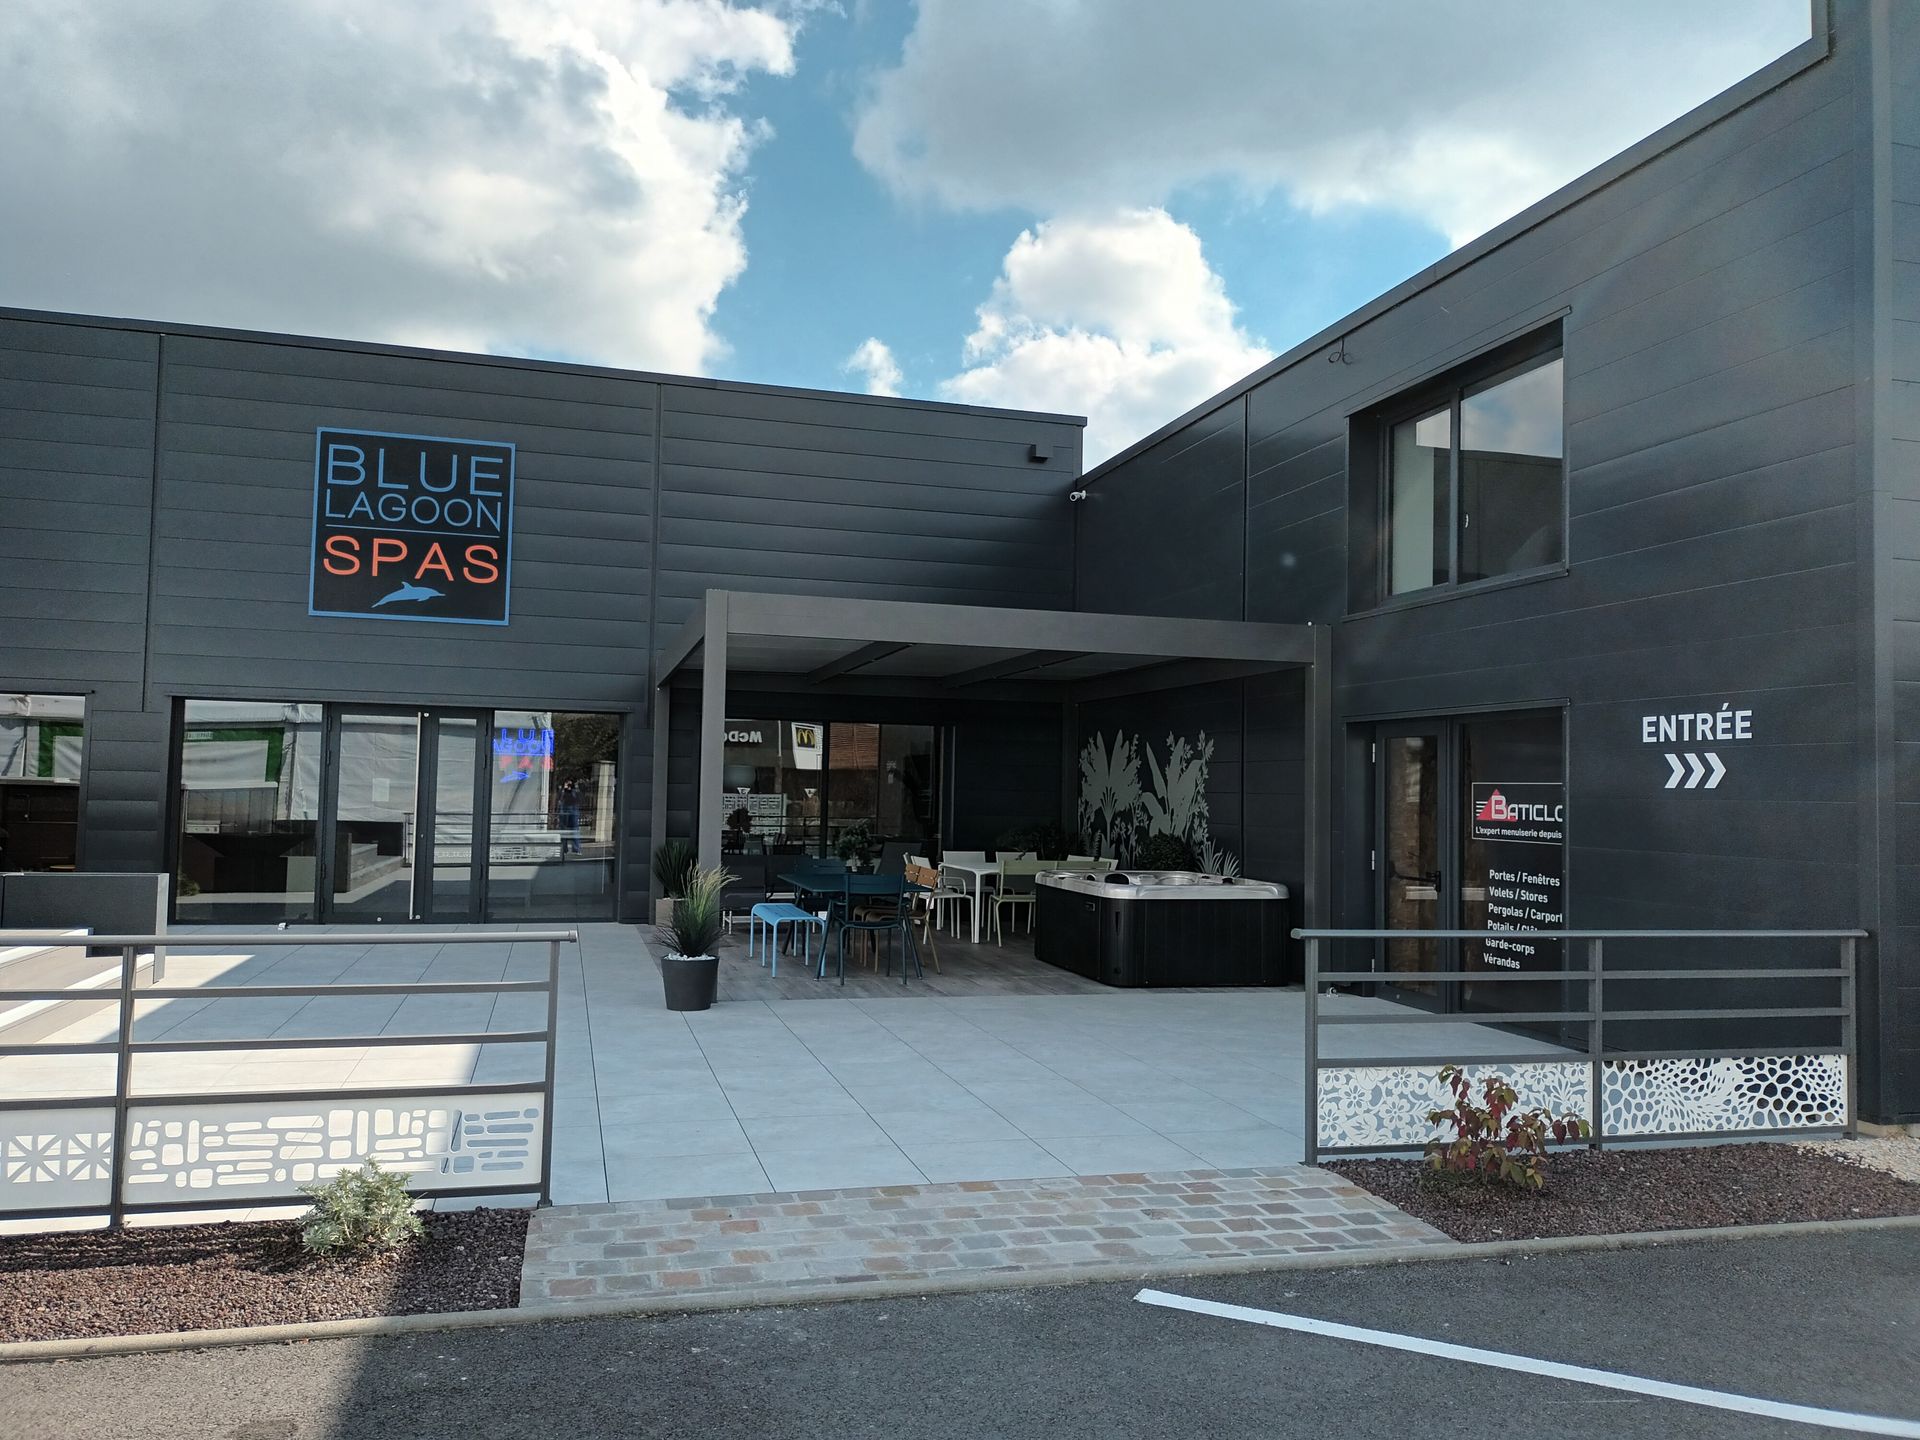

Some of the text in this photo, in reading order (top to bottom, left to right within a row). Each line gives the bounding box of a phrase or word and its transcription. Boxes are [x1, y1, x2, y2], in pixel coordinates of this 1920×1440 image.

[327, 443, 504, 497] BLUE
[325, 488, 502, 533] LAGOON
[322, 535, 499, 584] SPAS
[1642, 702, 1753, 743] ENTRÉE
[1475, 826, 1563, 840] L'expert menuiserie depuis
[1489, 869, 1516, 882] Portes
[1522, 872, 1560, 887] Fenêtres
[1489, 886, 1514, 899] Volets
[1520, 890, 1548, 903] Stores
[1488, 903, 1523, 917] Pergolas
[1483, 952, 1520, 969] Vérandas
